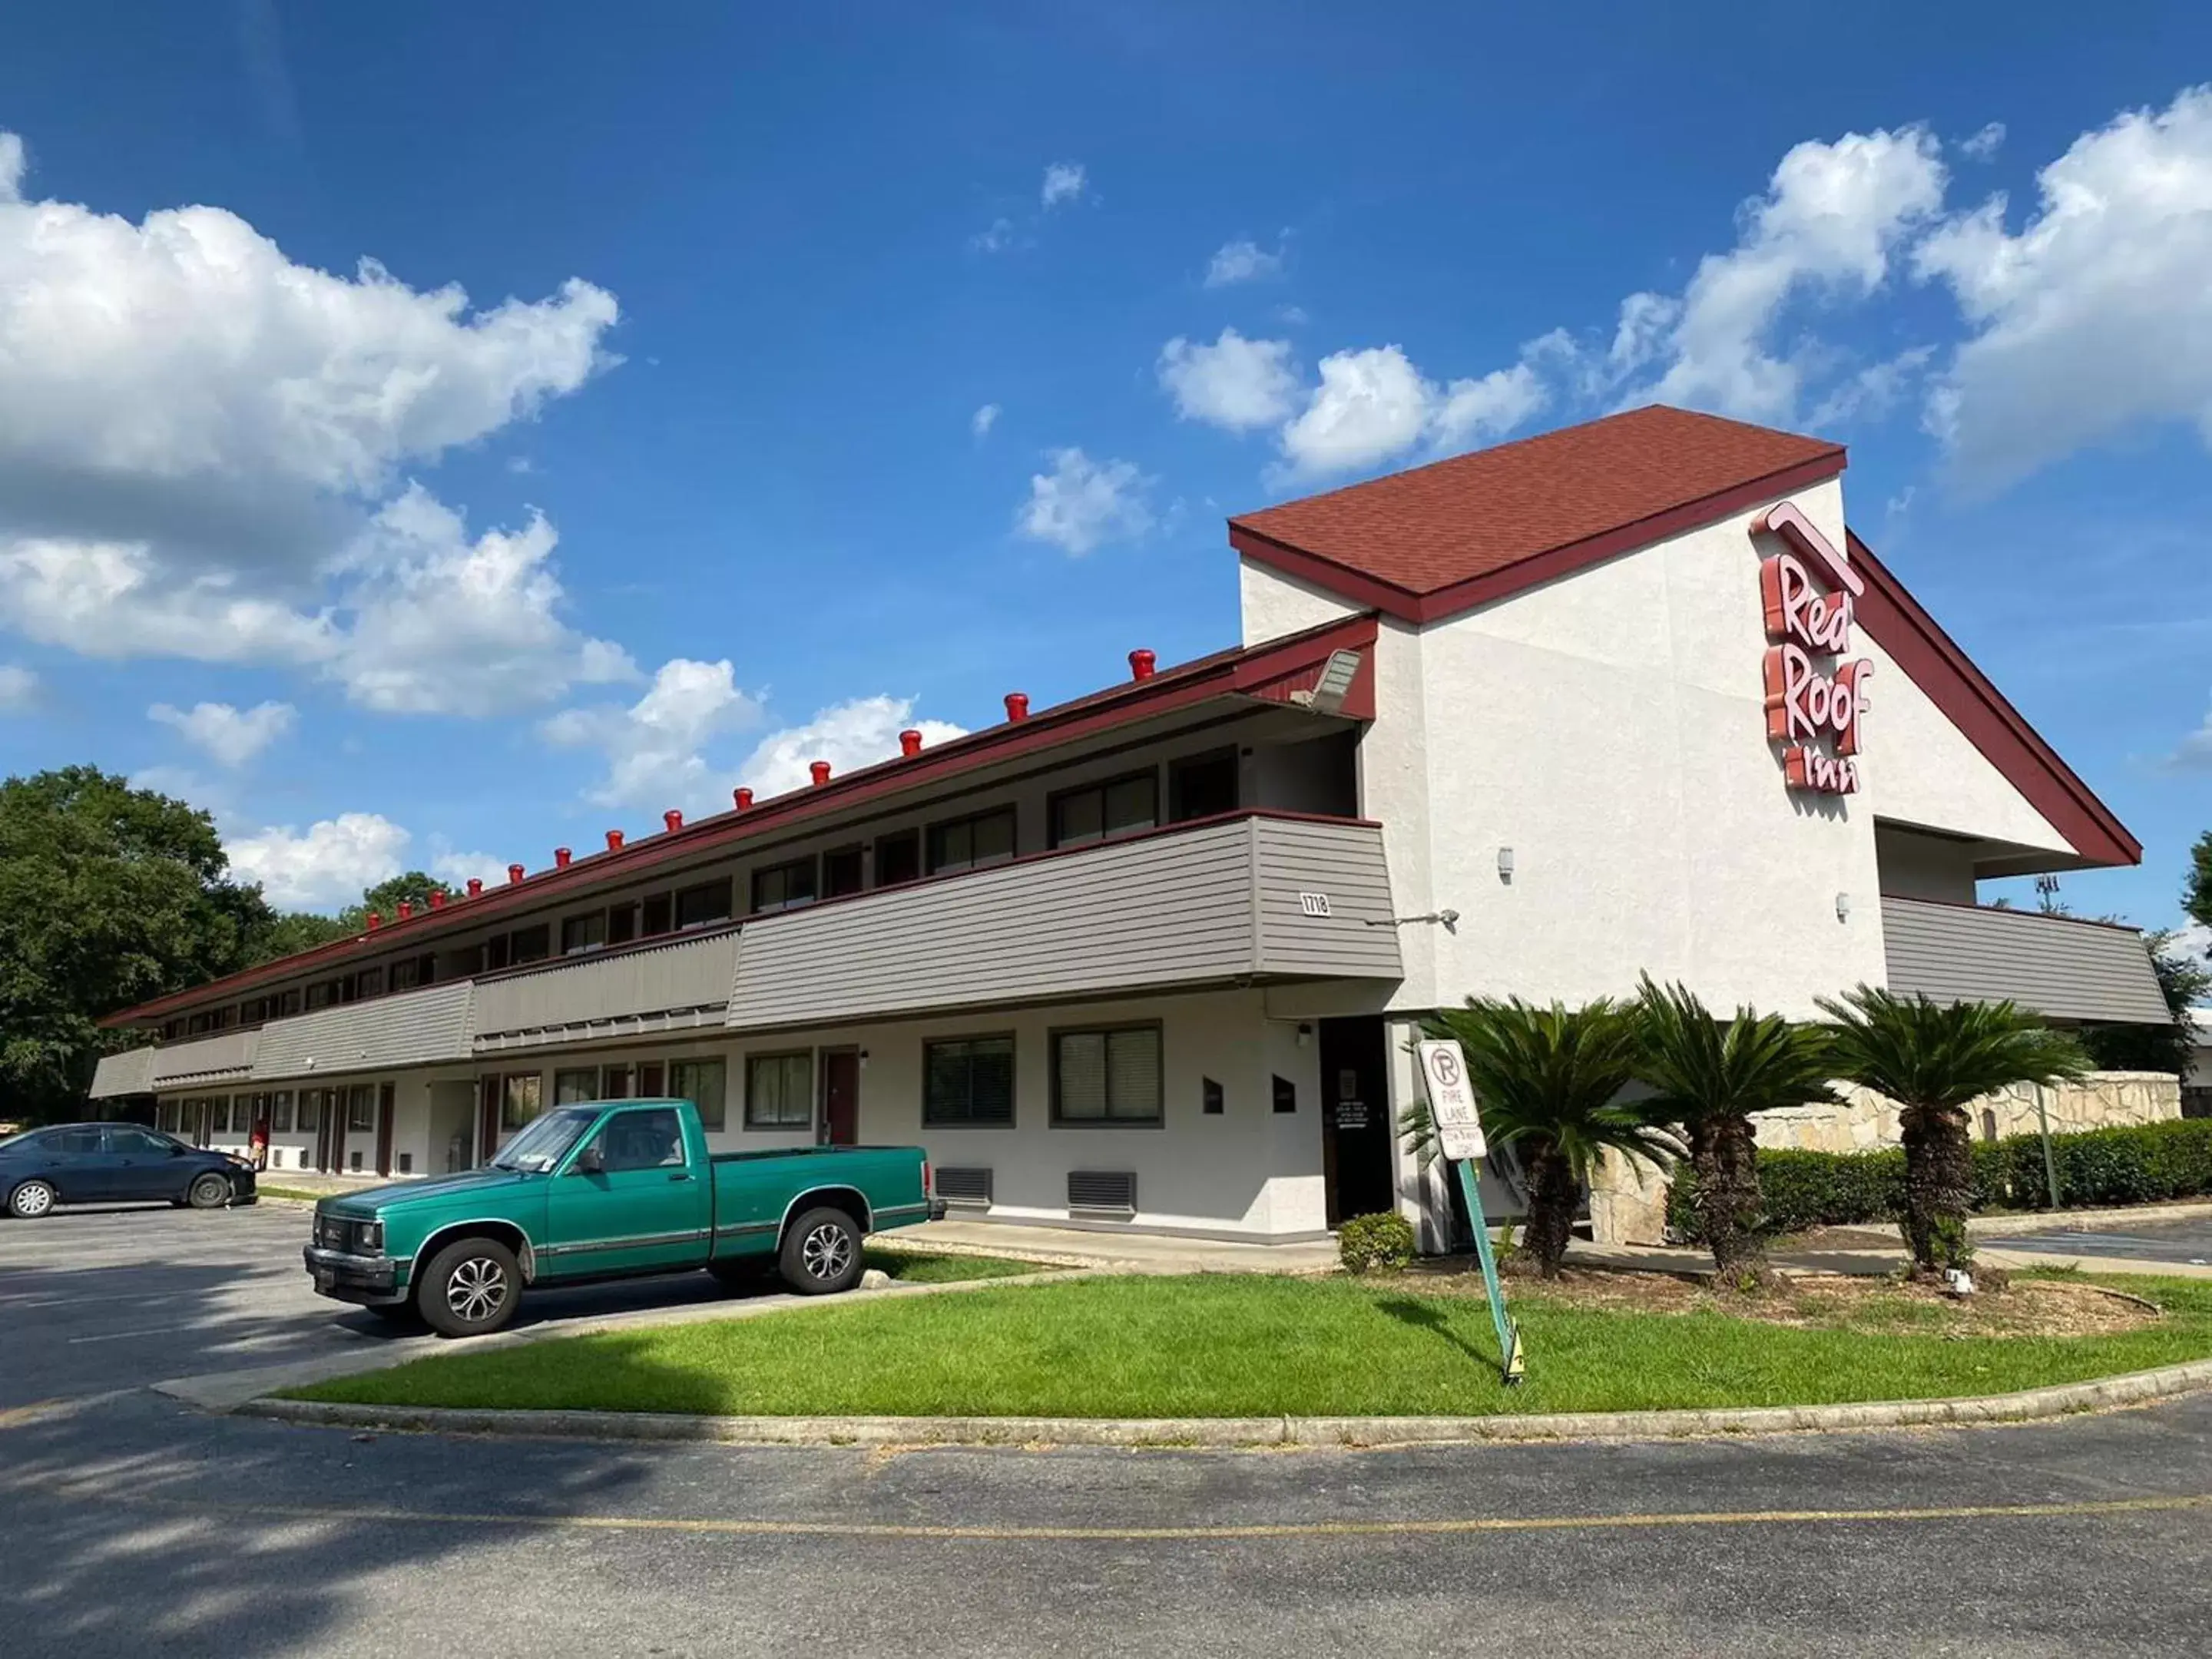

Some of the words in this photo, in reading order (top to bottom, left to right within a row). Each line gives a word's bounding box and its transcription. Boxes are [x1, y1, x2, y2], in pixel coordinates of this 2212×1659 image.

[1776, 555, 1853, 653] Red
[1780, 642, 1874, 757] Roof
[1444, 1107, 1470, 1121] LANE
